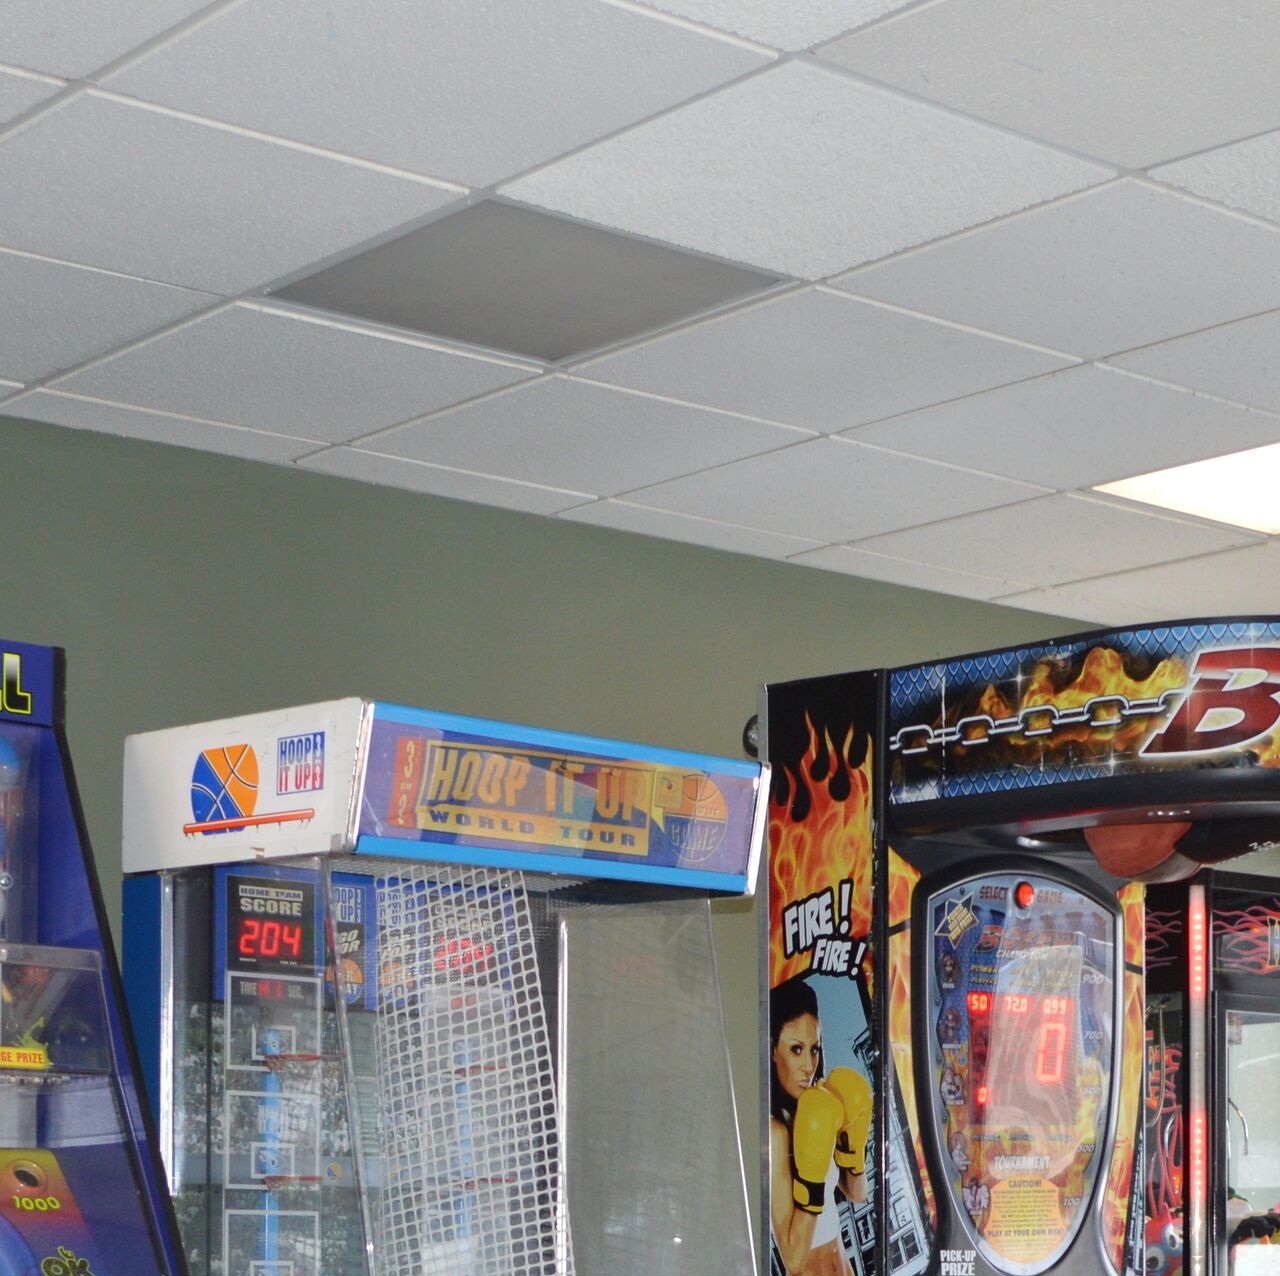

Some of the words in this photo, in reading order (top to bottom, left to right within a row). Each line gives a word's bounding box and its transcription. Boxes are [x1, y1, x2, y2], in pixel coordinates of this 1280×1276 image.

[279, 737, 312, 765] HOOP
[404, 740, 416, 779] 3
[279, 766, 290, 792] IT
[294, 763, 311, 790] UP
[427, 746, 532, 806] HOOP
[546, 761, 586, 815] IT
[595, 767, 650, 820] UP
[429, 810, 536, 834] WORLD
[560, 825, 636, 847] TOUR
[240, 886, 270, 896] HOME
[980, 885, 1009, 900] SELECT
[1036, 889, 1064, 903] GAME
[240, 898, 303, 916] SCORE
[239, 920, 303, 956] 204
[995, 950, 1049, 961] CHAMPION
[1080, 972, 1105, 985] 900
[239, 981, 258, 995] TIME
[971, 994, 988, 1010] 50
[1082, 1031, 1104, 1040] 700
[15, 1051, 44, 1065] PRIZE
[993, 1155, 1051, 1170] TOURNAMENT
[1008, 1179, 1043, 1188] CAUTION!
[14, 1195, 61, 1212] 1000
[1062, 1198, 1080, 1206] 100
[940, 1249, 976, 1262] PICK-UP
[941, 1262, 976, 1276] PRIZE
